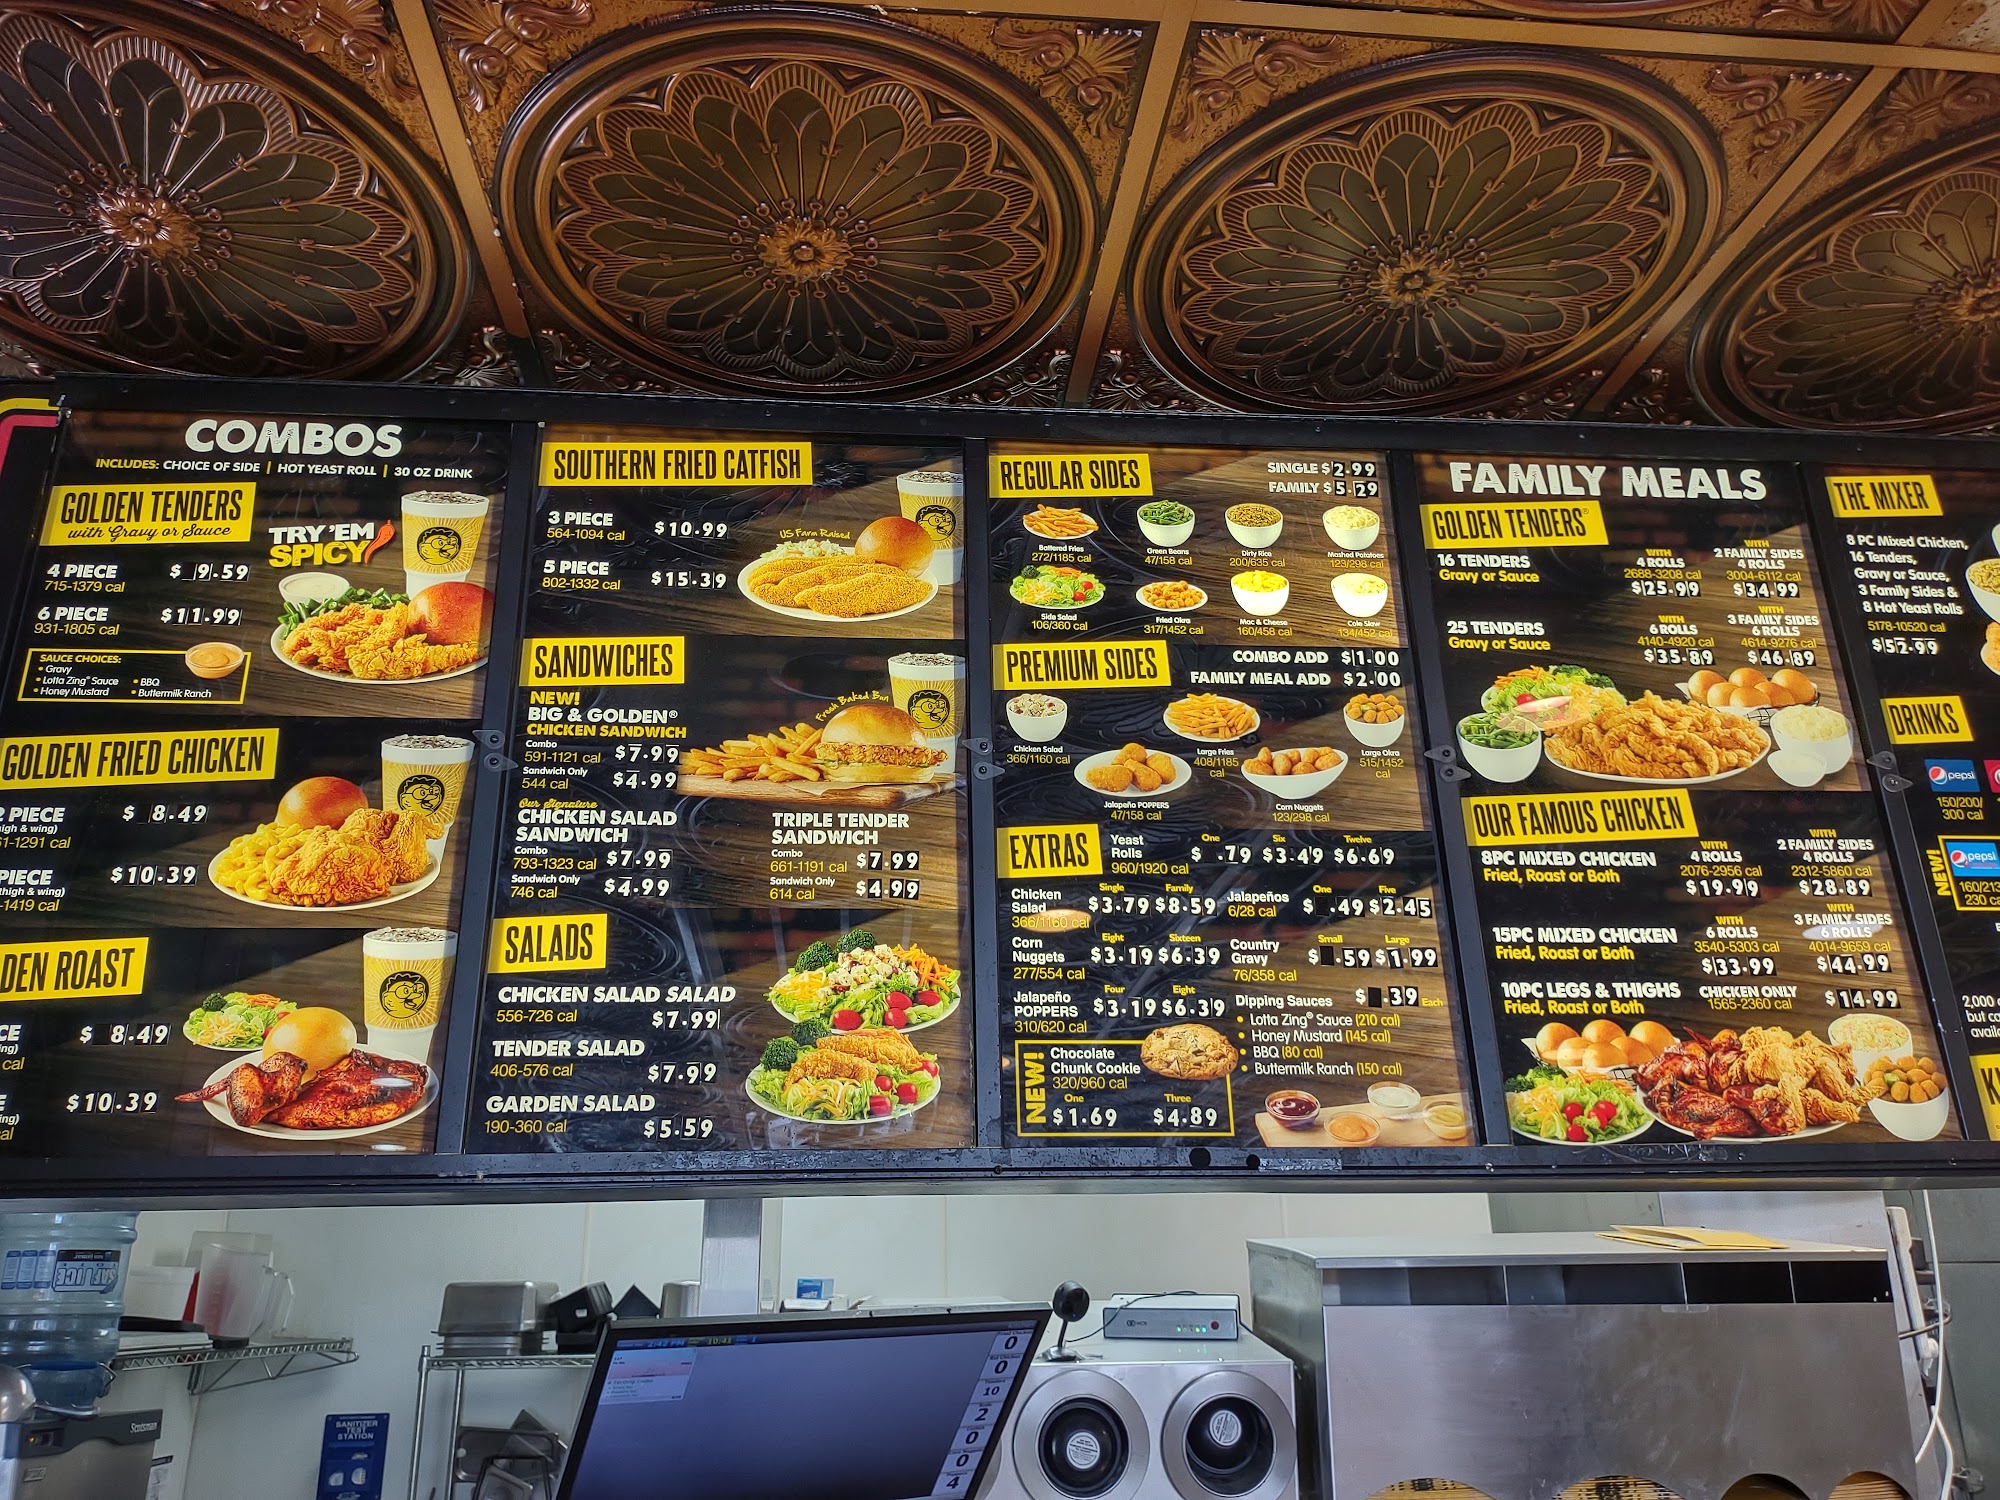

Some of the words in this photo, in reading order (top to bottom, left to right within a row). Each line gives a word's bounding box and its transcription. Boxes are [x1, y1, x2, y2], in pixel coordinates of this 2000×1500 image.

[185, 419, 402, 457] COMBOS
[96, 458, 159, 470] INCLUDES:
[163, 461, 210, 472] CHOICE
[213, 462, 230, 473] OF
[232, 462, 260, 473] SIDE
[277, 462, 305, 474] HOT
[307, 463, 342, 475] YEAST
[345, 464, 377, 476] ROLL
[394, 466, 411, 478] 30
[413, 466, 431, 478] OZ
[434, 467, 473, 479] DRINK
[553, 450, 655, 480] SOUTHERN
[663, 449, 717, 480] FRIED
[723, 448, 801, 479] CATFISH
[1268, 462, 1319, 474] SINGLE
[1000, 461, 1087, 490] REGULAR
[1090, 460, 1140, 489] SIDES
[1449, 462, 1606, 496] FAMILY
[1622, 466, 1767, 500] MEALS
[1269, 482, 1320, 494] FAMILY
[1833, 483, 1870, 510] THE
[1870, 482, 1929, 510] MIXER
[61, 491, 144, 523] GOLDEN
[151, 490, 243, 522] TENDERS
[548, 512, 560, 525] 3
[564, 512, 613, 526] PIECE
[68, 527, 105, 540] with
[108, 526, 158, 541] Gravy
[162, 527, 179, 537] or
[183, 524, 232, 537] Sauce
[269, 526, 326, 545] TRY
[654, 521, 728, 538] $10.99
[1846, 534, 1855, 546] 8
[1857, 535, 1875, 546] PC
[1878, 535, 1914, 548] Mixed
[1917, 537, 1969, 550] Chicken,
[269, 542, 369, 567] SPICY
[1438, 554, 1455, 567] 16
[1459, 554, 1530, 569] TENDERS
[1850, 551, 1864, 562] 16
[1866, 551, 1918, 565] Tenders,
[48, 565, 56, 577] 4
[60, 564, 118, 579] PIECE
[544, 560, 555, 574] 5
[559, 561, 609, 576] PIECE
[651, 571, 726, 589] $15.39
[1440, 570, 1478, 583] Gravy
[1481, 572, 1496, 582] or
[1498, 571, 1539, 583] Sauce
[44, 580, 102, 592] 715-1379
[105, 581, 125, 592] cal
[1631, 581, 1700, 597] $25.99
[1734, 581, 1798, 597] $34.99
[37, 607, 50, 621] 6
[54, 606, 109, 622] PIECE
[161, 608, 242, 626] $11.99
[1447, 621, 1467, 634] 25
[1470, 621, 1544, 636] TENDERS
[40, 654, 72, 663] SAUCE
[76, 655, 122, 664] CHOICES:
[534, 644, 673, 679] SANDWICHES
[1007, 649, 1101, 682] PREMIUM
[1105, 648, 1158, 680] SIDES
[1232, 651, 1291, 664] COMBO
[1294, 651, 1328, 664] ADD
[1191, 672, 1245, 685] FAMILY
[1249, 672, 1293, 685] MEAL
[1296, 673, 1331, 686] ADD
[530, 691, 580, 705] NEW!
[1889, 703, 1959, 735] DRINKS
[526, 723, 596, 737] CHICKEN
[599, 725, 686, 738] SANDWICH
[2, 743, 90, 780] GOLDEN
[99, 739, 163, 776] FRIED
[167, 735, 265, 772] CHICKEN
[524, 751, 579, 762] 591-1121
[582, 751, 601, 762] cal
[7, 806, 65, 823] PIECE
[517, 811, 605, 825] CHICKEN
[609, 811, 677, 826] SALAD
[772, 813, 834, 827] TRIPLE
[838, 813, 909, 829] TENDER
[1473, 802, 1515, 837] OUR
[1518, 800, 1598, 836] FAMOUS
[1601, 796, 1685, 833] CHICKEN
[516, 827, 628, 843] SANDWICH
[772, 830, 878, 845] SANDWICH
[1111, 835, 1143, 846] Yeast
[1010, 833, 1089, 870] EXTRAS
[1111, 847, 1142, 859] Rolls
[1481, 850, 1514, 866] 8PC
[1519, 850, 1575, 867] MIXED
[1578, 851, 1657, 868] CHICKEN
[111, 866, 196, 886] $10.39
[1926, 849, 1951, 896] NEW!
[1011, 889, 1062, 900] Chicken
[1227, 891, 1289, 905] Jalapeños
[1012, 902, 1046, 914] Salad
[505, 923, 593, 964] SALADS
[1012, 937, 1042, 948] Corn
[1493, 927, 1534, 943] 15PC
[1538, 927, 1597, 944] MIXED
[1599, 927, 1678, 945] CHICKEN
[1012, 951, 1065, 964] Nuggets
[54, 948, 135, 991] ROAST
[498, 987, 590, 1003] CHICKEN
[593, 987, 660, 1003] SALAD
[665, 986, 736, 1002] SALAD
[1501, 982, 1543, 998] 10PC
[1547, 982, 1592, 998] LEGS
[1595, 982, 1610, 998] &
[1613, 982, 1681, 999] THIGHS
[1235, 995, 1285, 1009] Dipping
[1288, 996, 1332, 1008] Sauces
[1251, 1030, 1291, 1043] Honey
[1294, 1030, 1342, 1043] Mustard
[493, 1040, 571, 1057] TENDER
[576, 1040, 645, 1056] SALAD
[1050, 1047, 1115, 1060] Chocolate
[1051, 1062, 1093, 1074] Chunk
[1096, 1062, 1141, 1074] Cookie
[1025, 1052, 1046, 1123] NEW!
[66, 1092, 158, 1113] $10.39
[486, 1095, 578, 1113] GARDEN
[582, 1094, 655, 1112] SALAD
[983, 1387, 999, 1396] 10
[975, 1409, 988, 1421] 2
[130, 1423, 157, 1433] Scotsman
[336, 1420, 378, 1428] SANITIZER
[947, 1476, 959, 1489] 4
